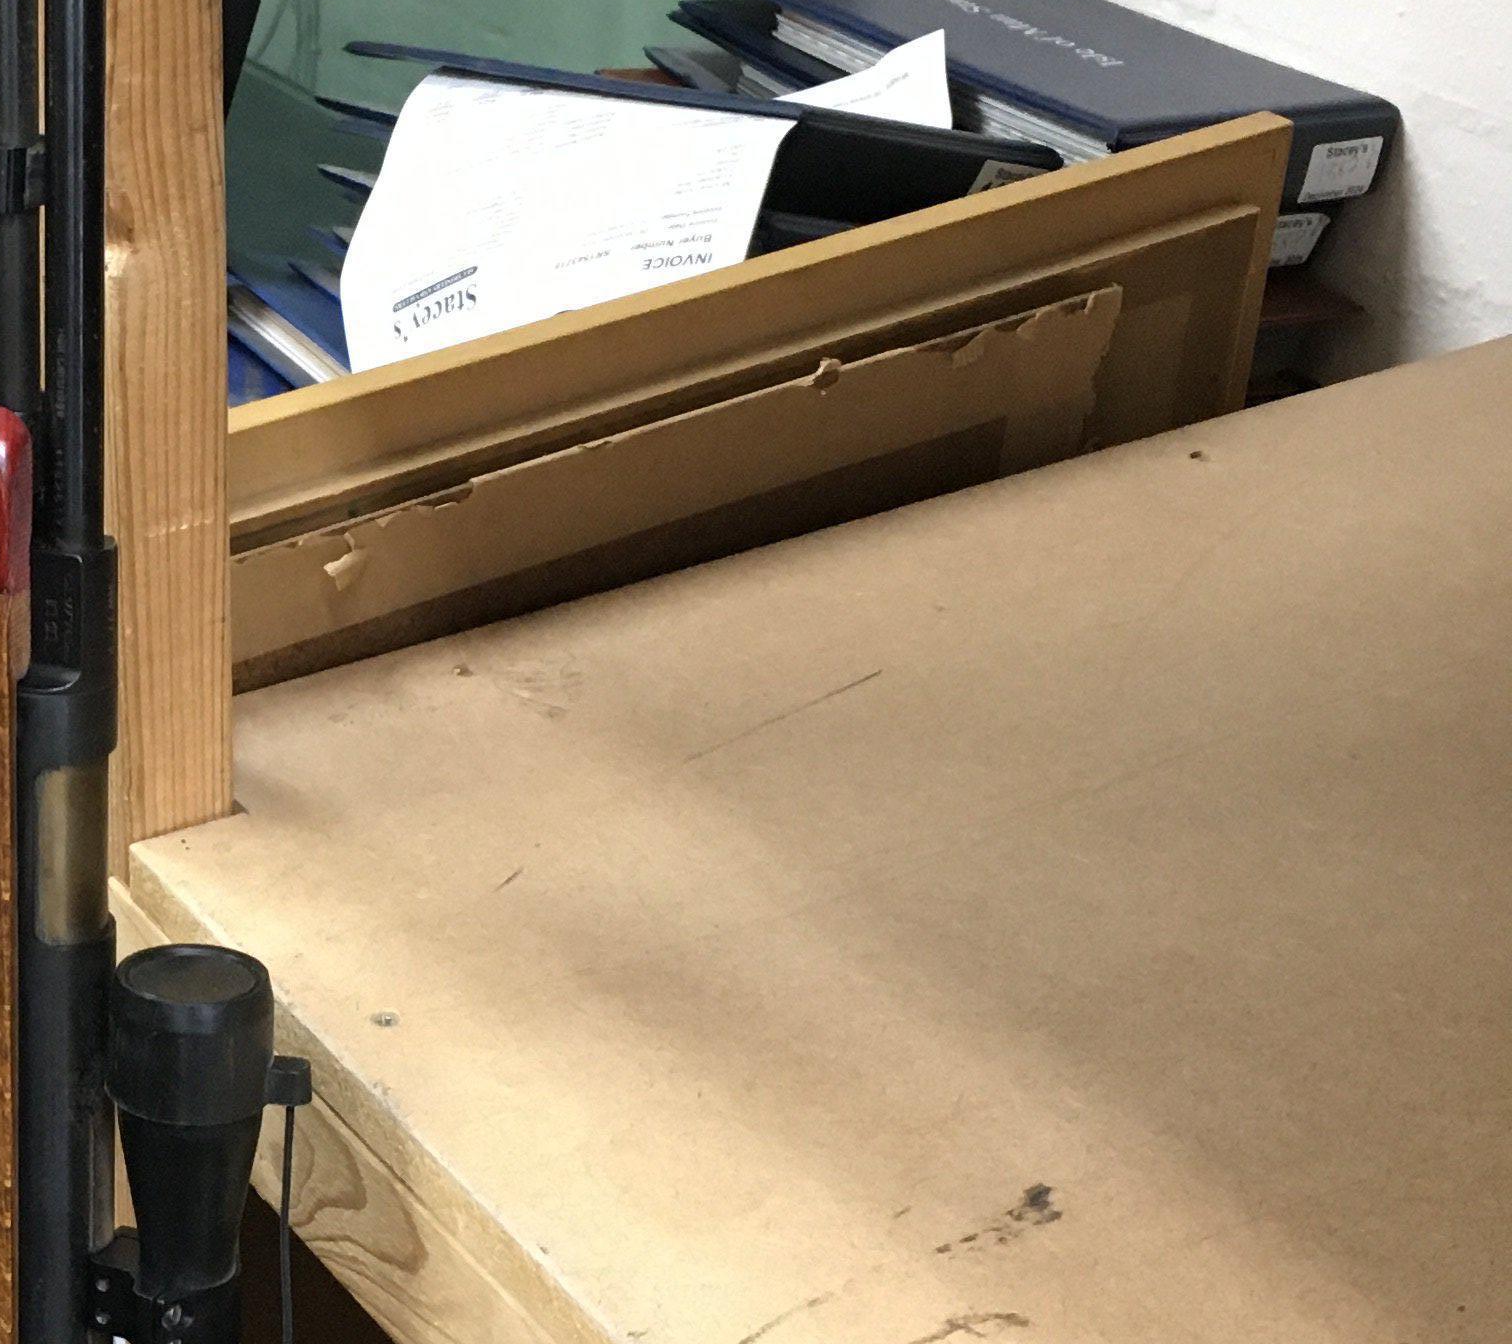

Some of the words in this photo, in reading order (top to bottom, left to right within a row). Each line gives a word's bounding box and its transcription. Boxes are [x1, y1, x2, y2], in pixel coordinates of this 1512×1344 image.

[630, 239, 675, 251] Number
[679, 234, 712, 245] Buyer
[642, 253, 713, 270] INVOICE
[393, 282, 477, 343] Stacey's
